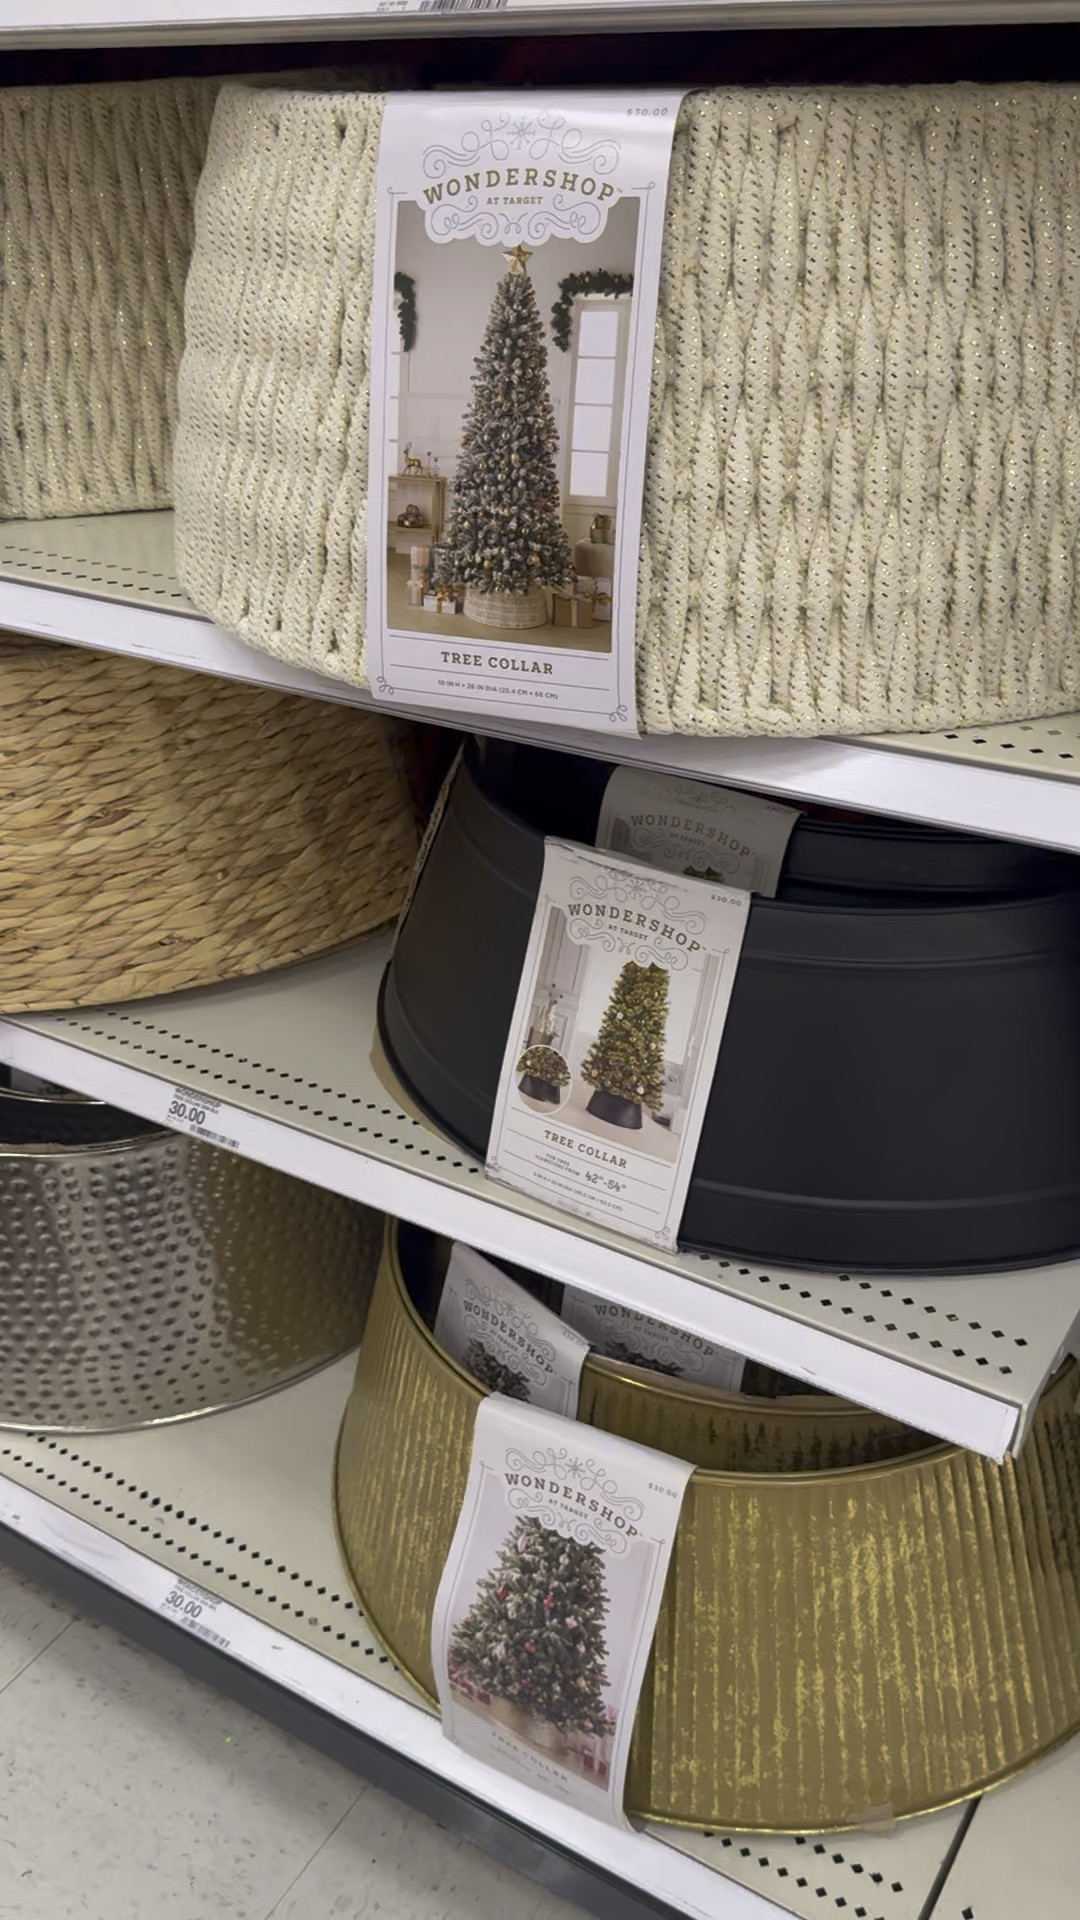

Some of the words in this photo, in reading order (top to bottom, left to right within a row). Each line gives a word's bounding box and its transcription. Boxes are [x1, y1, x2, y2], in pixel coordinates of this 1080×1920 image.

[625, 107, 668, 117] $30.00
[423, 168, 615, 205] WONDERSHOP
[486, 197, 501, 205] AT
[503, 196, 544, 206] TARGET
[441, 651, 483, 667] TREE
[488, 657, 553, 675] COLLAR
[545, 692, 559, 700] CM)
[631, 814, 751, 858] WONDERSHOP
[568, 904, 700, 953] WONDERSHOP
[620, 927, 648, 940] TARGET
[169, 1100, 206, 1125] 30.00
[544, 1130, 573, 1149] TREE
[577, 1143, 627, 1169] COLLAR
[463, 1300, 553, 1374] WONDERSHOP
[594, 1305, 714, 1356] WONDERSHOP
[505, 1473, 638, 1537] WONDERSHOP
[165, 1590, 203, 1618] 30.00
